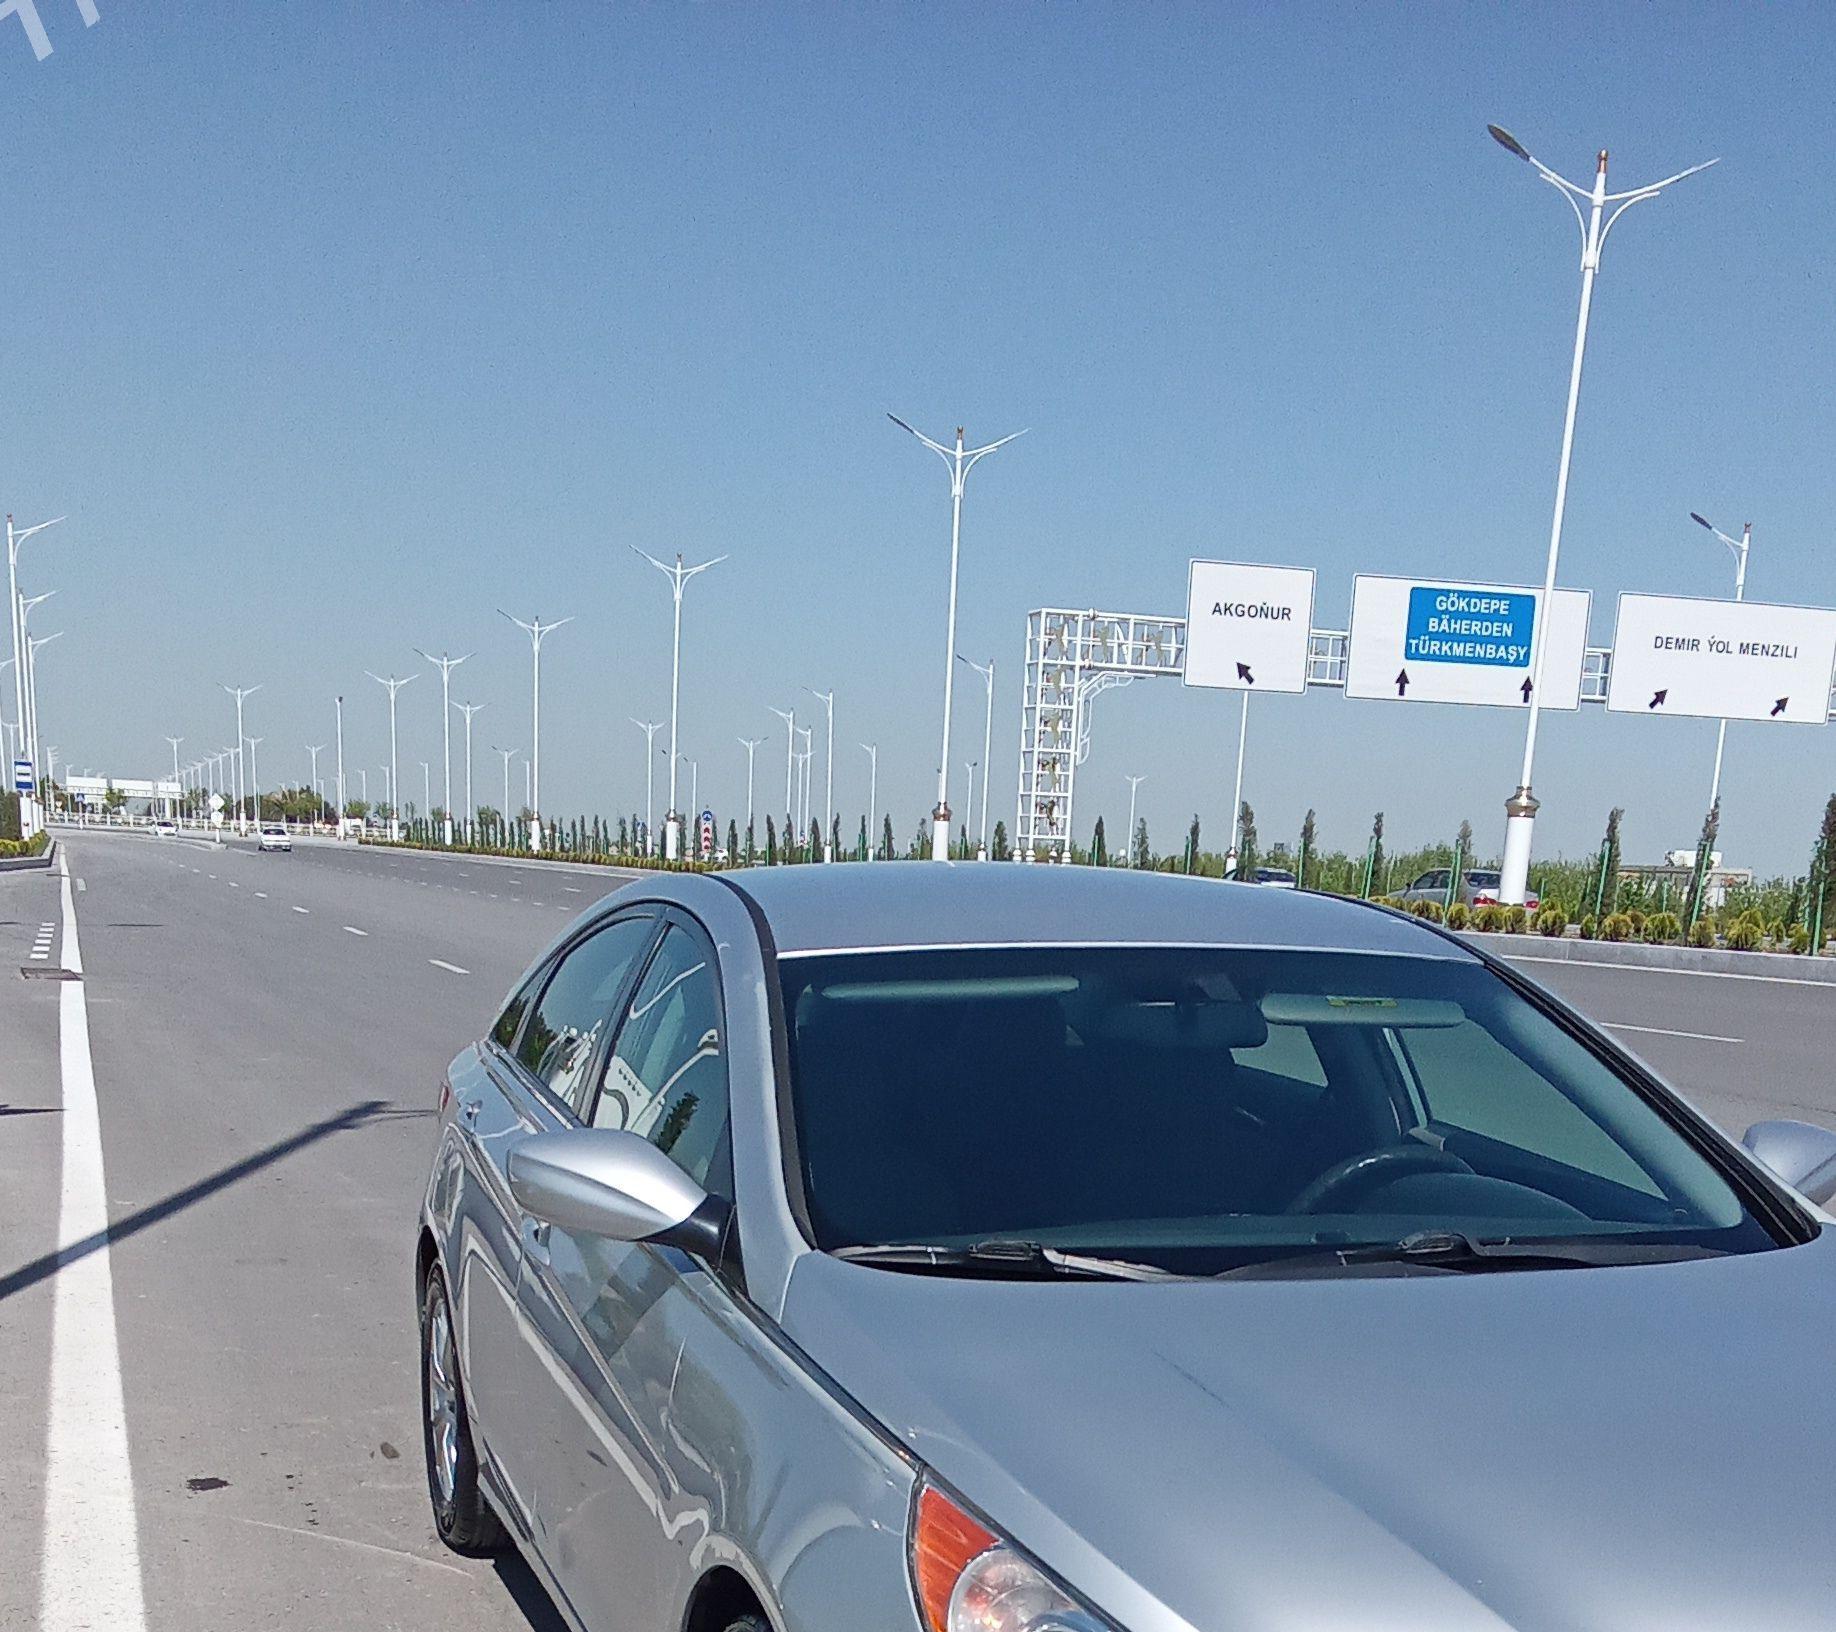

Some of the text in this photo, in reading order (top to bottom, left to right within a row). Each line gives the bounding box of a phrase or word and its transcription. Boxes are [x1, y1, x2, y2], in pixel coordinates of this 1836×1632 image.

[1211, 602, 1292, 621] AKGOŇUR
[1435, 592, 1511, 615] GÖKDEPE
[1428, 614, 1513, 638] BÄHERDEN
[1409, 635, 1529, 664] TÜRKMENBAŞY
[1654, 634, 1798, 660] DEMIR ÝOL MENZILI
